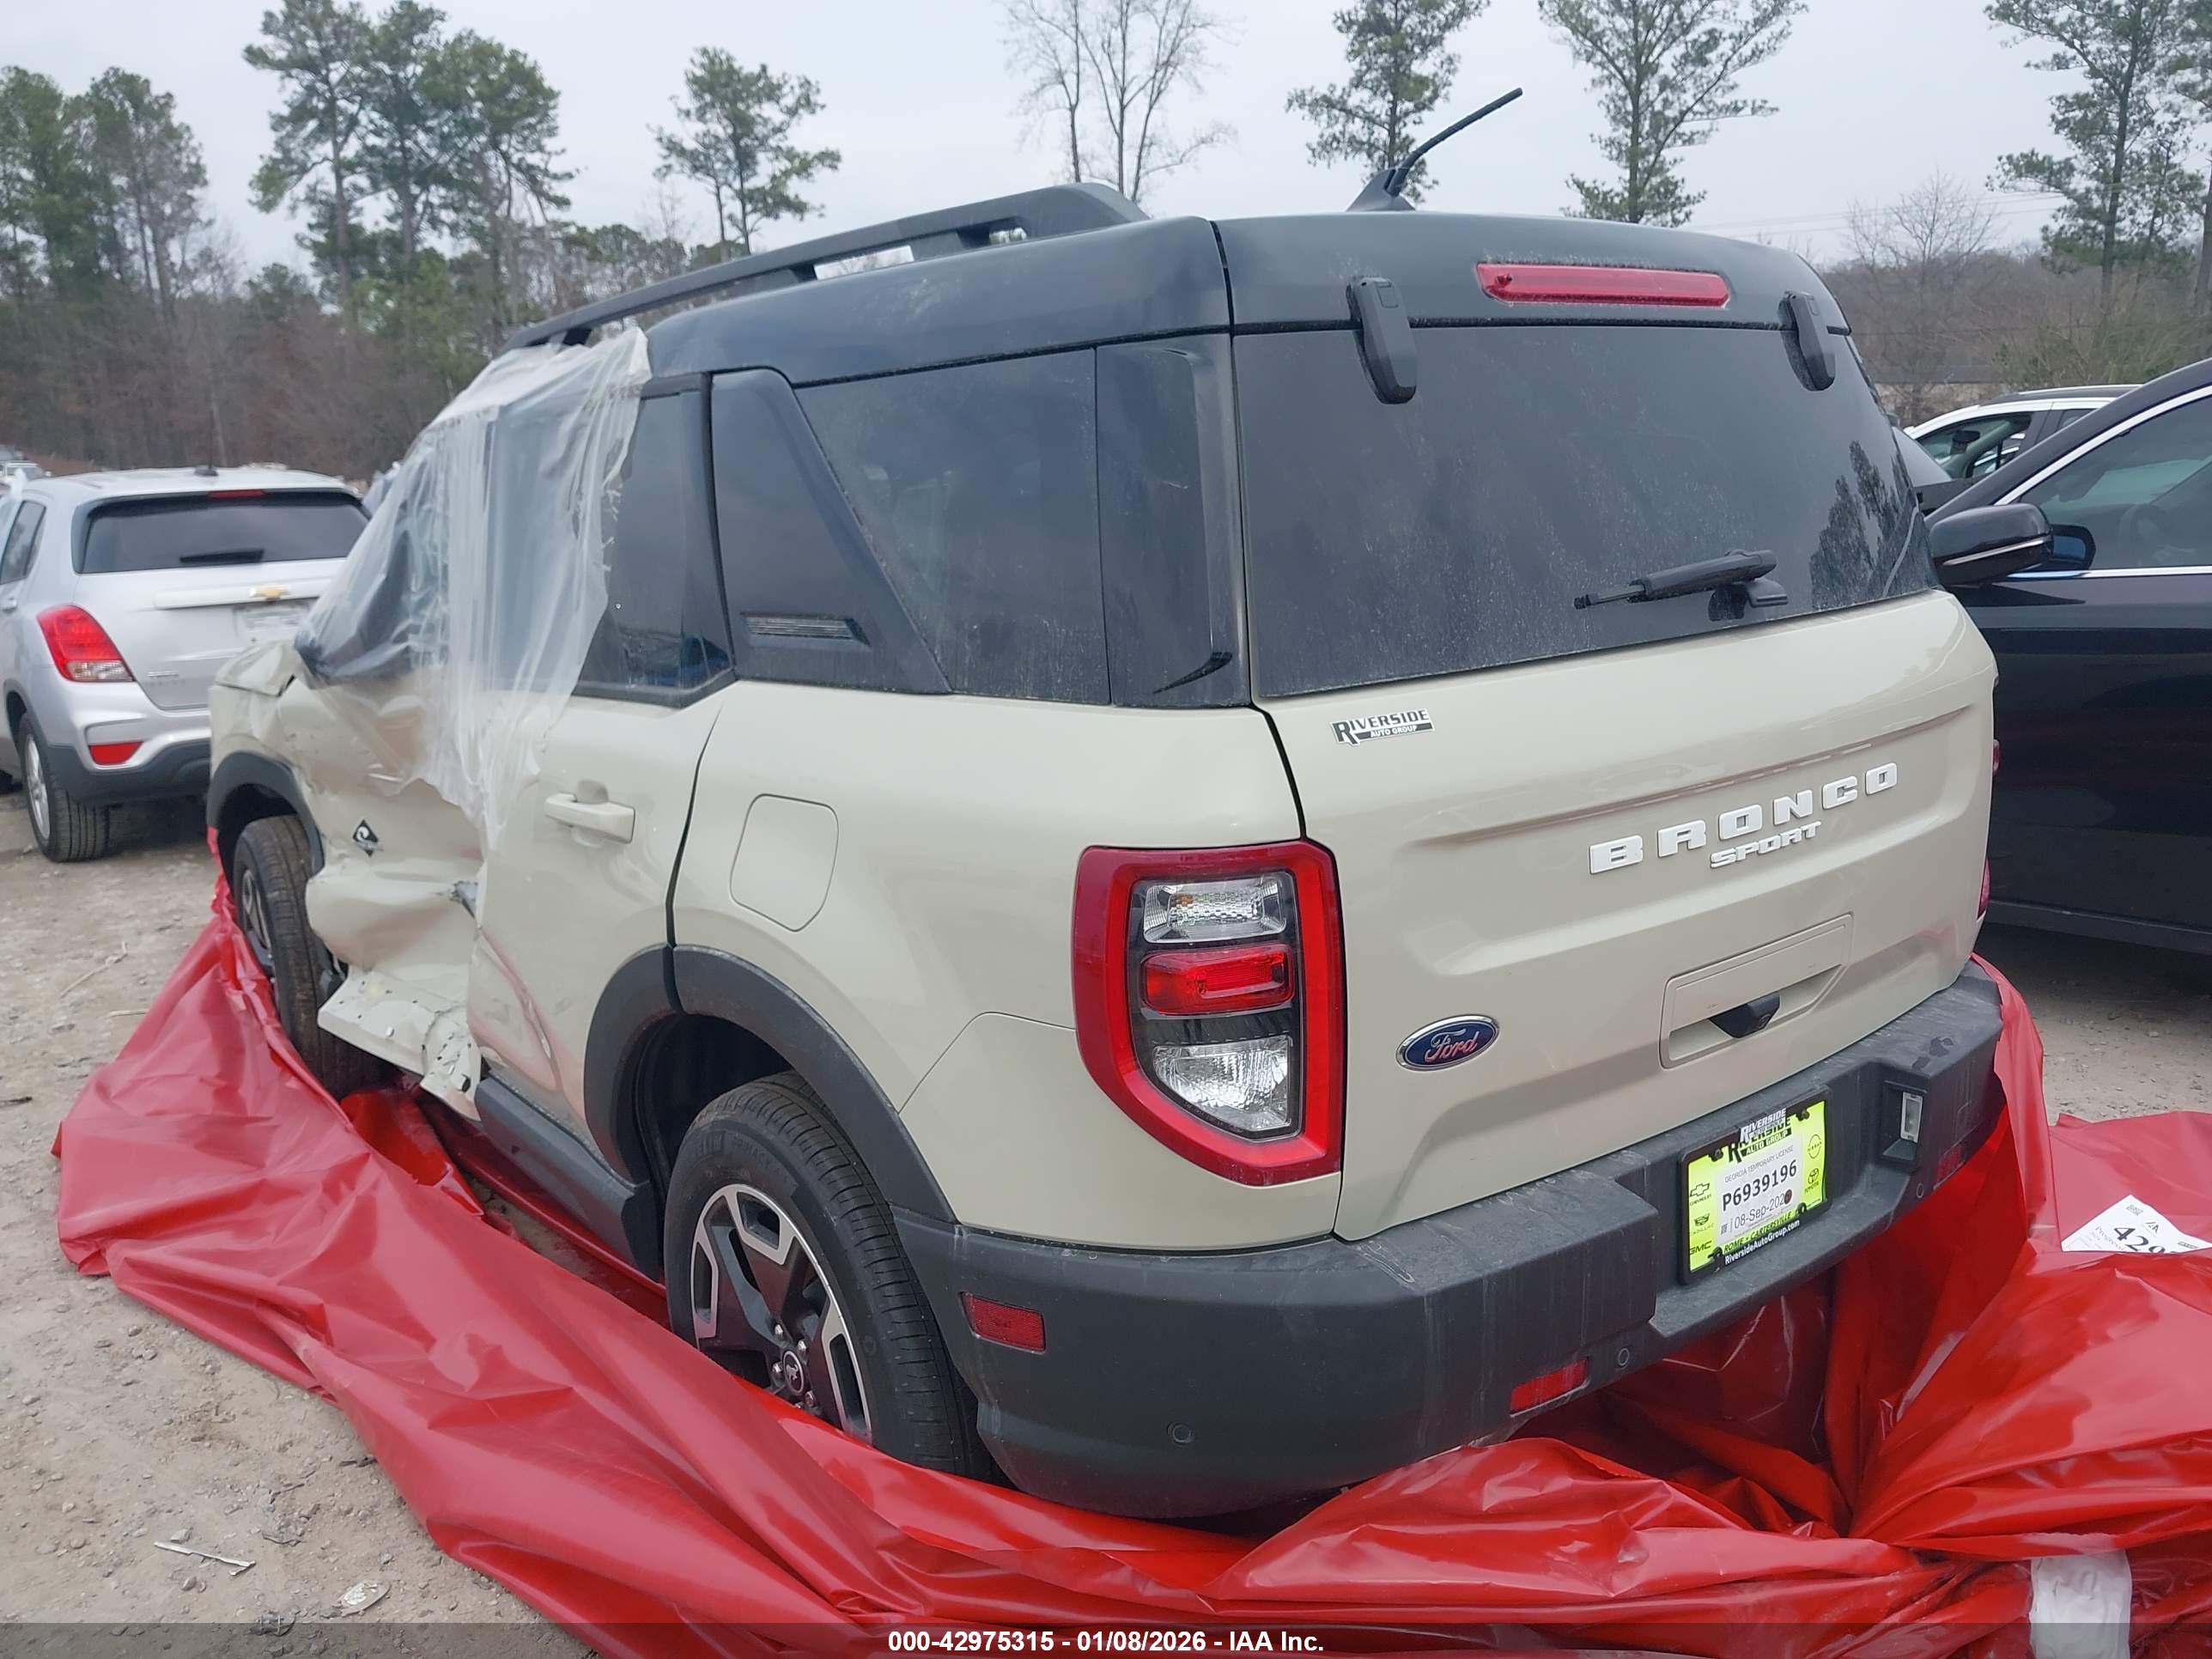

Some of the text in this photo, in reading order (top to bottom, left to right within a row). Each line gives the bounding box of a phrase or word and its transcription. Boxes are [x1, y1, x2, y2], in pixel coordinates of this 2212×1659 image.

[1333, 709, 1430, 744] RIVERSIDE
[1370, 725, 1418, 738] AUTO GROUP
[1589, 763, 1898, 874] BRONCO
[1710, 821, 1821, 869] SPORT
[1425, 1028, 1480, 1062] Ford
[1740, 1108, 1787, 1143] RIVERSIDE
[1723, 1159, 1797, 1212] P6939196
[1734, 1191, 1793, 1230] 08-Sep-202
[1724, 1219, 1801, 1266] RiversideAutoGroup.com
